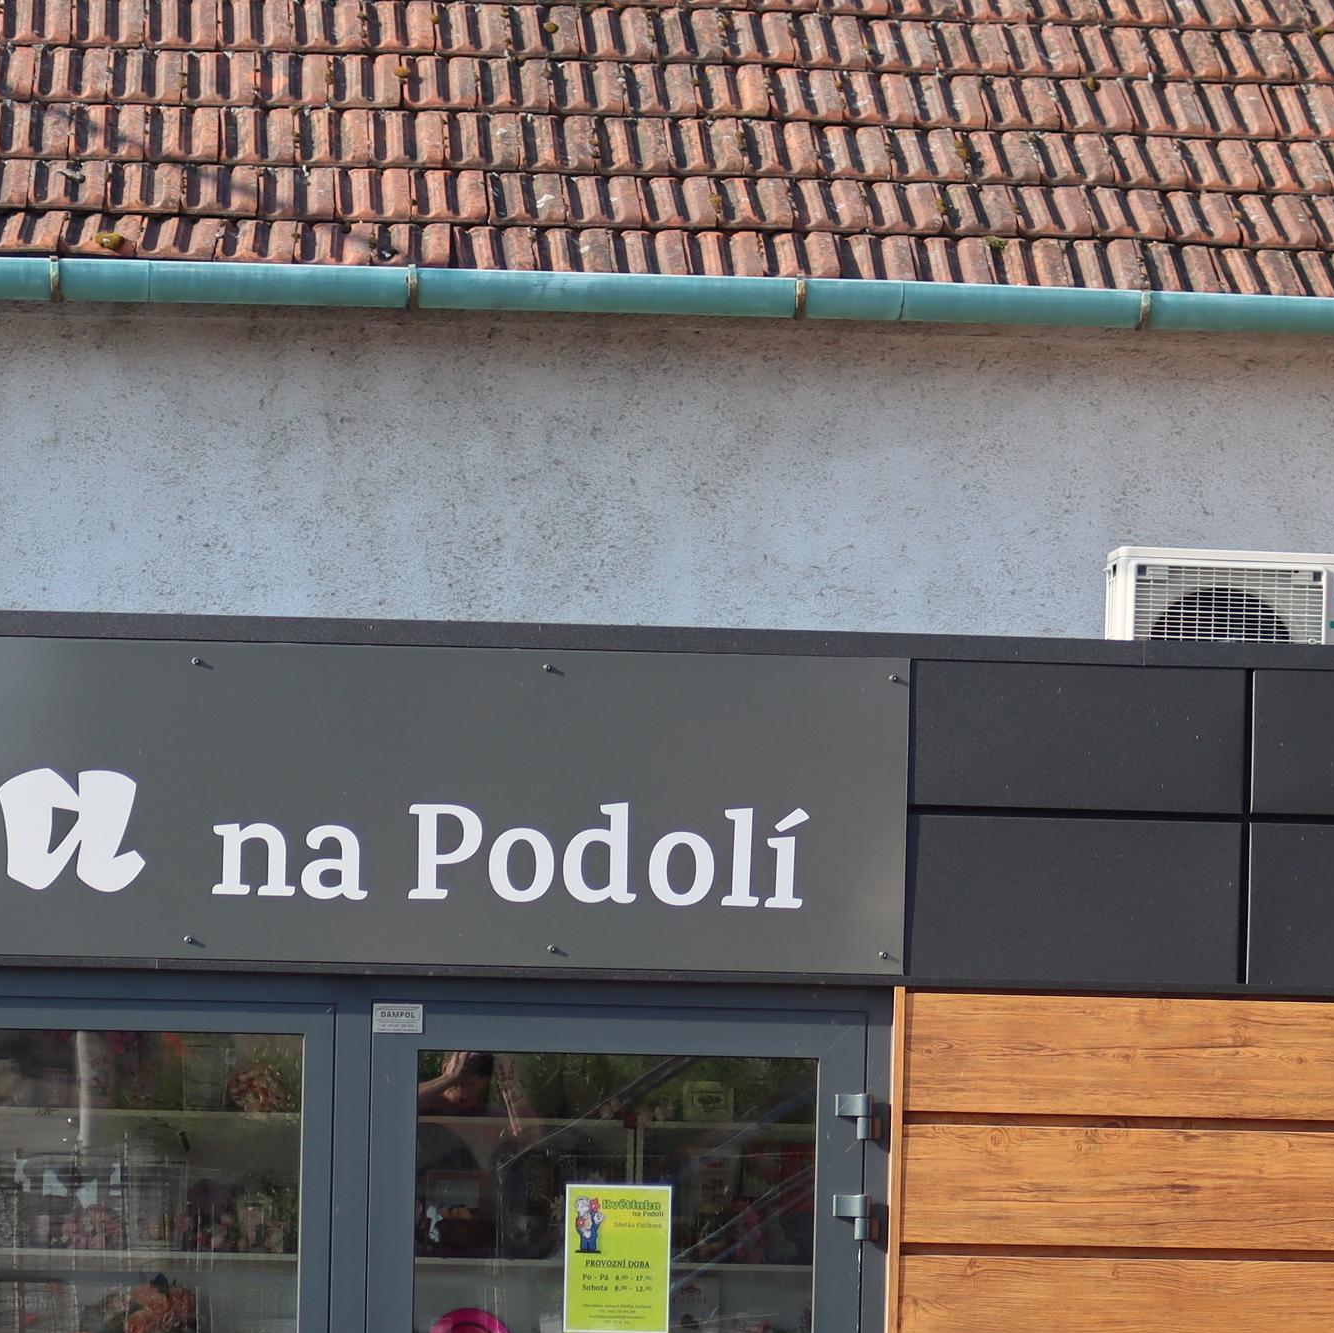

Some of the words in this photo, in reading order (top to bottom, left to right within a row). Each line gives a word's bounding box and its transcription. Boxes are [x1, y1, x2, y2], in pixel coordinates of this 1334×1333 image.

[212, 821, 369, 901] na
[408, 801, 810, 909] Podolí
[380, 1011, 415, 1019] DAMPOL
[585, 1259, 626, 1268] PROVOZNÍ
[628, 1260, 651, 1269] DOBA
[582, 1273, 592, 1281] Po
[599, 1273, 609, 1281] Pá
[582, 1284, 608, 1292] Sobota
